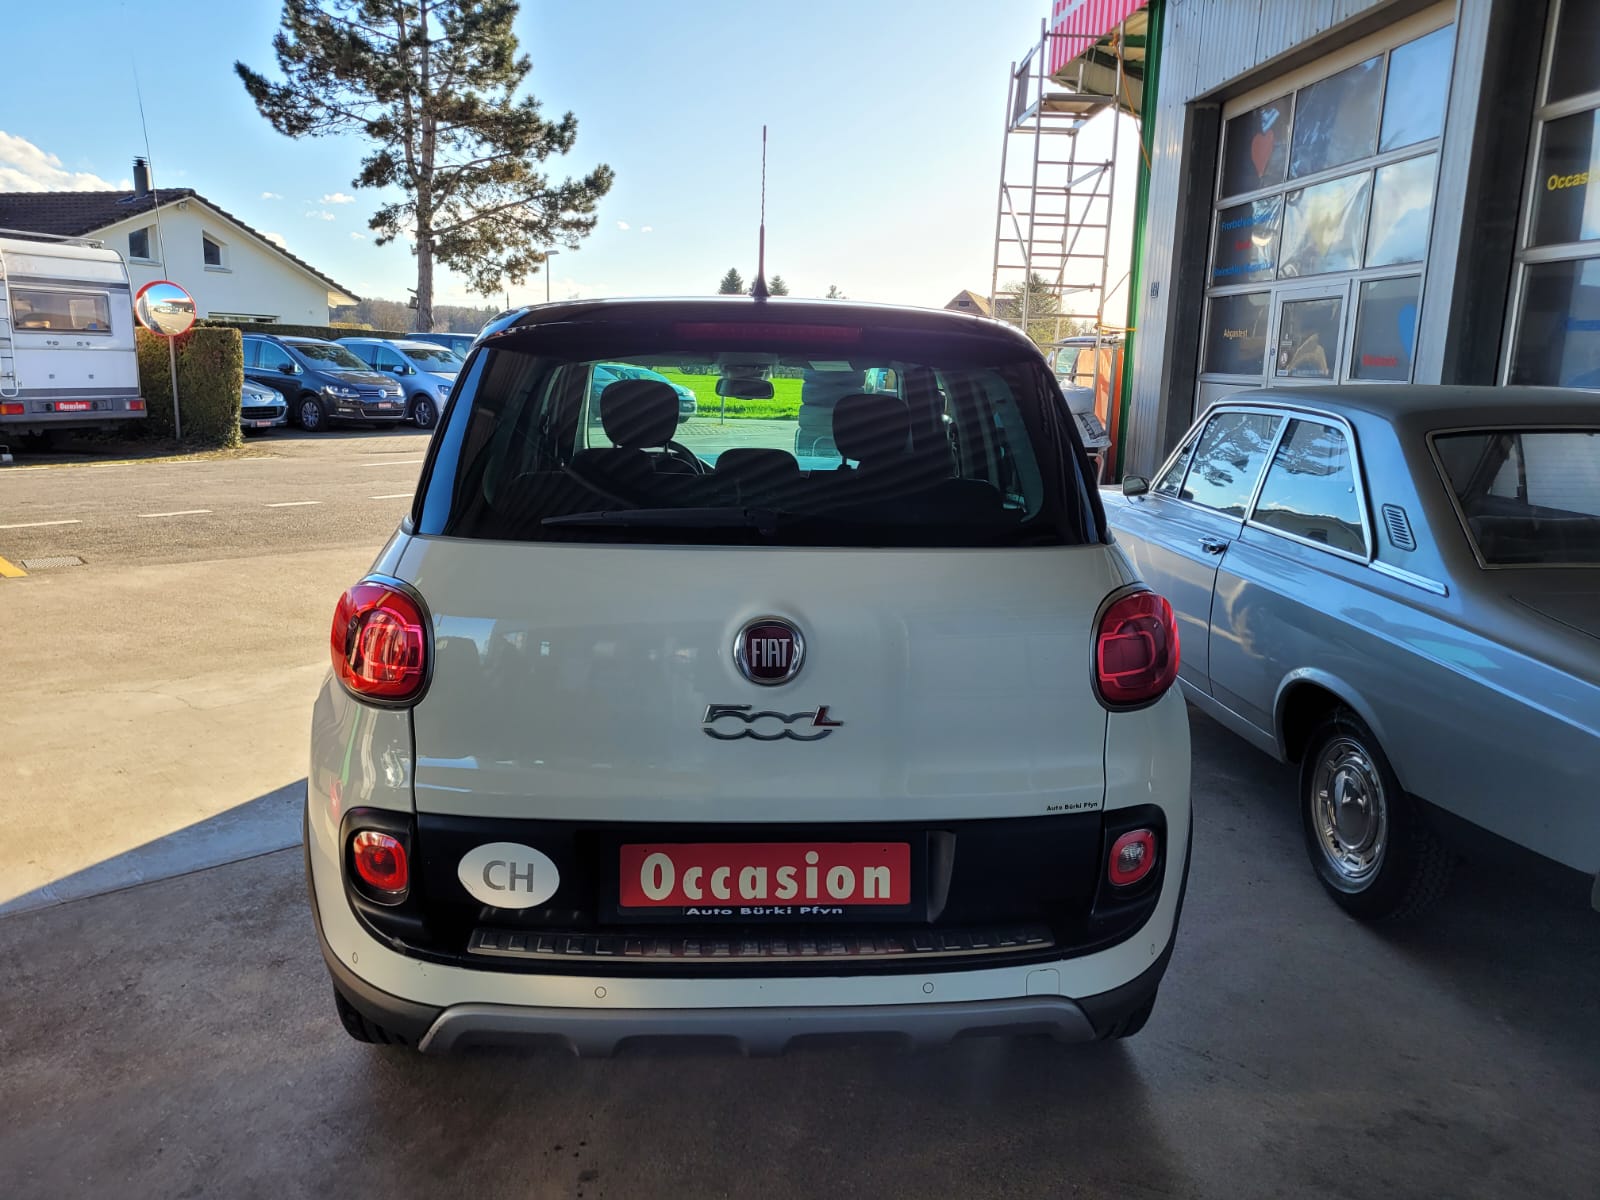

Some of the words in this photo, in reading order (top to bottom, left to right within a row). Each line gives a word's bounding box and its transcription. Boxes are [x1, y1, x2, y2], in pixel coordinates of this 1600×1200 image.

[1547, 172, 1599, 190] Occas
[751, 638, 790, 667] FIAT
[702, 703, 844, 741] 500L
[482, 860, 534, 893] CH
[640, 851, 891, 901] Occasion
[686, 907, 733, 916] Auto
[740, 906, 792, 916] Bürki
[799, 906, 843, 916] Pfyn
